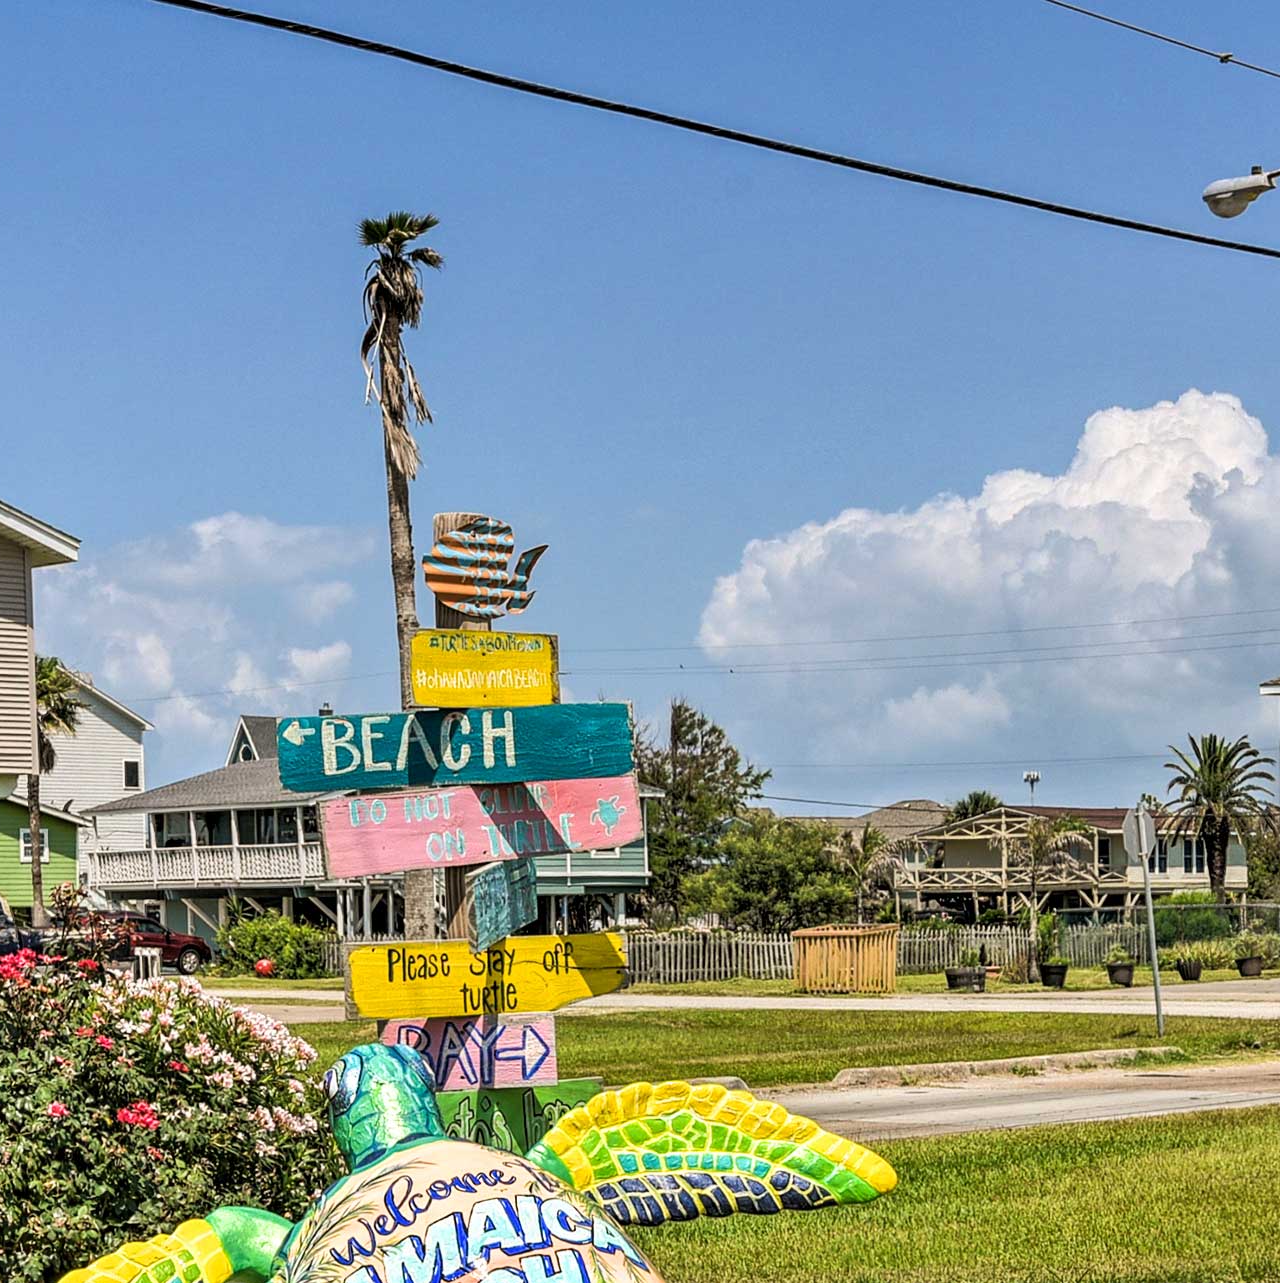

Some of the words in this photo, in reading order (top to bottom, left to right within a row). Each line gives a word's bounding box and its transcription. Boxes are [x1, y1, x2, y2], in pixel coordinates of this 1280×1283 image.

[322, 711, 517, 776] BEACH
[348, 798, 388, 827] DO
[404, 792, 456, 824] NOT
[480, 783, 554, 817] CLIMB
[426, 828, 467, 862] ON
[482, 812, 583, 859] TURTLE
[388, 948, 451, 982] Please
[543, 942, 574, 975] off
